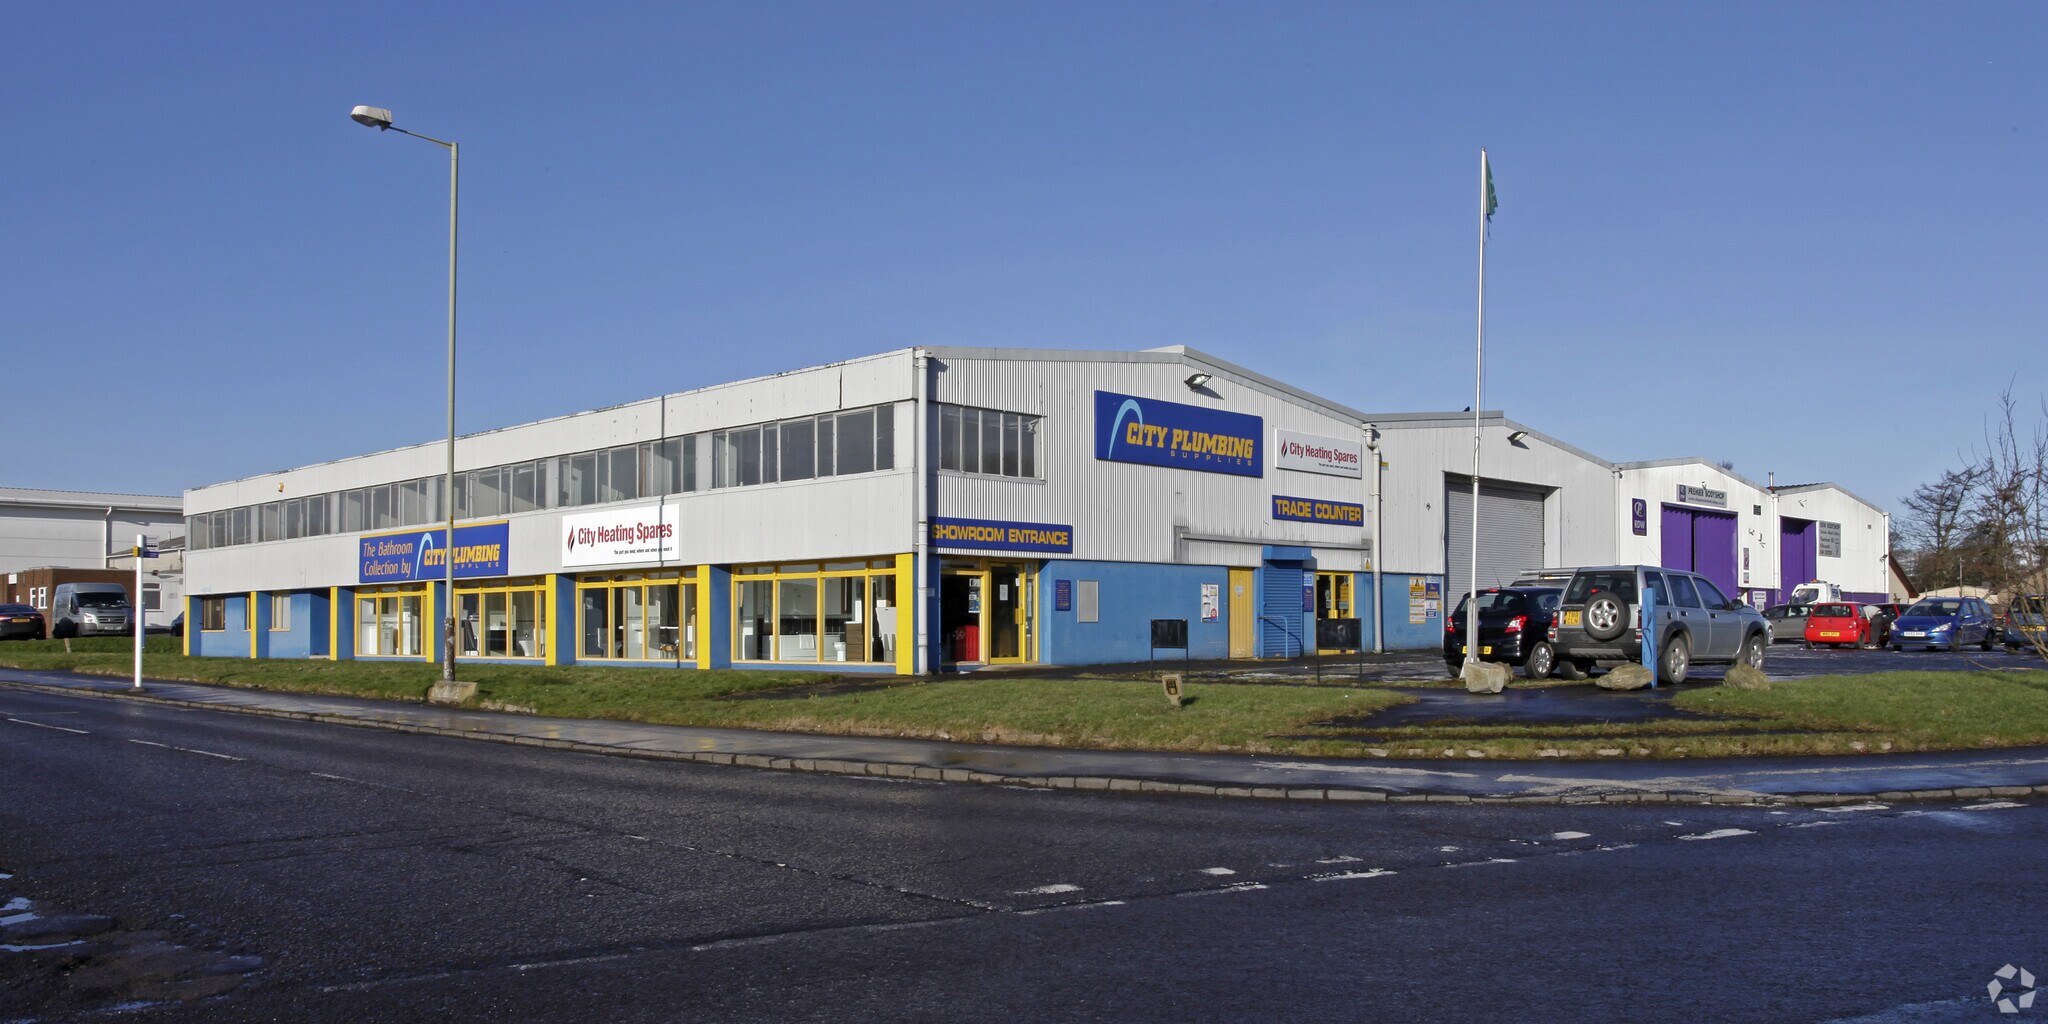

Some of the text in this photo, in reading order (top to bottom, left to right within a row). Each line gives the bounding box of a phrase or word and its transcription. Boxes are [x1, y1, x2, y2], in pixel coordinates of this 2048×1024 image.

[1126, 422, 1254, 459] CITY PLUMBING
[1170, 450, 1253, 466] SUPPLIES
[1290, 442, 1358, 464] City Heating Spares
[1276, 499, 1362, 522] TRADE COUNTER
[578, 522, 673, 548] City Heating Spares
[932, 524, 1069, 545] SHOWROOM ENTRANCE
[363, 540, 413, 558] The Bathroom
[424, 544, 500, 566] CITY LUMBING
[364, 558, 412, 578] Collection by
